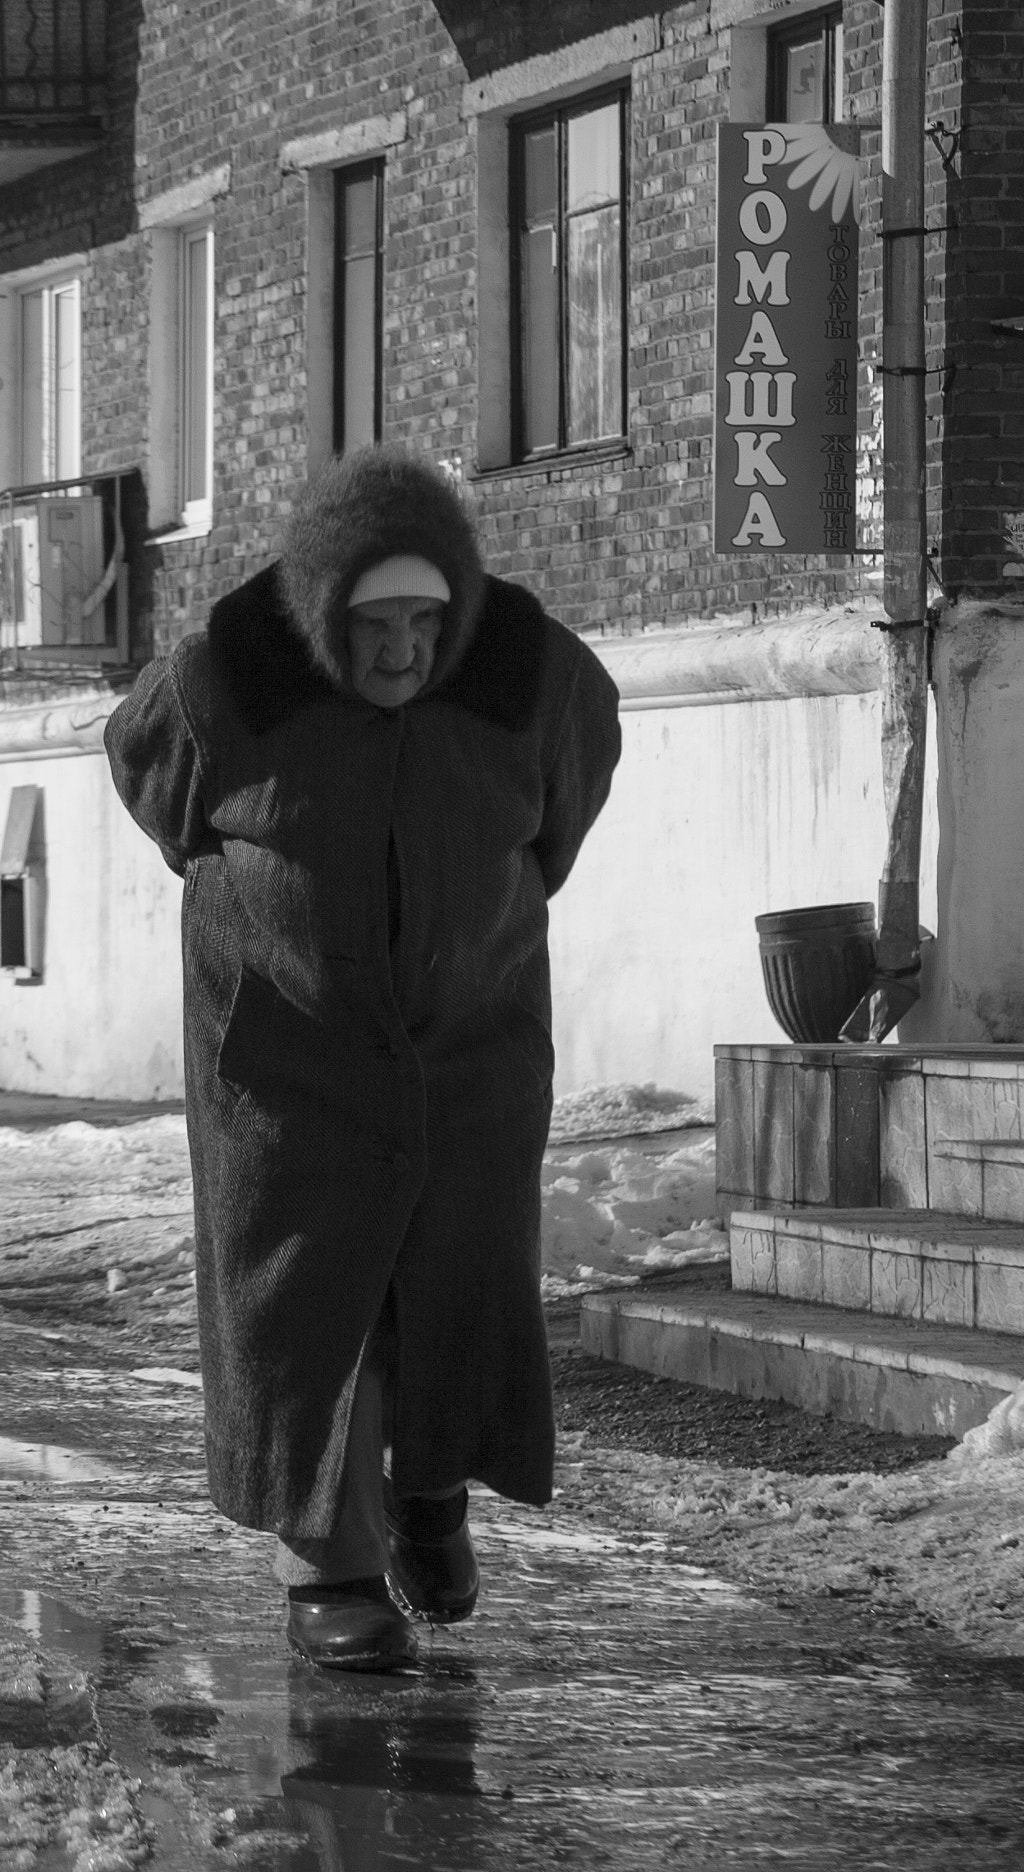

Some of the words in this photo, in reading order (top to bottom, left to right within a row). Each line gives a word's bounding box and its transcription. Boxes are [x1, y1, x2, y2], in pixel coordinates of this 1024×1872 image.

[725, 130, 797, 547] РОМАШКА
[825, 225, 851, 339] ТОВАРЫ
[825, 358, 849, 415] ДЛЯ
[820, 434, 852, 548] ЖЕНЩИН
